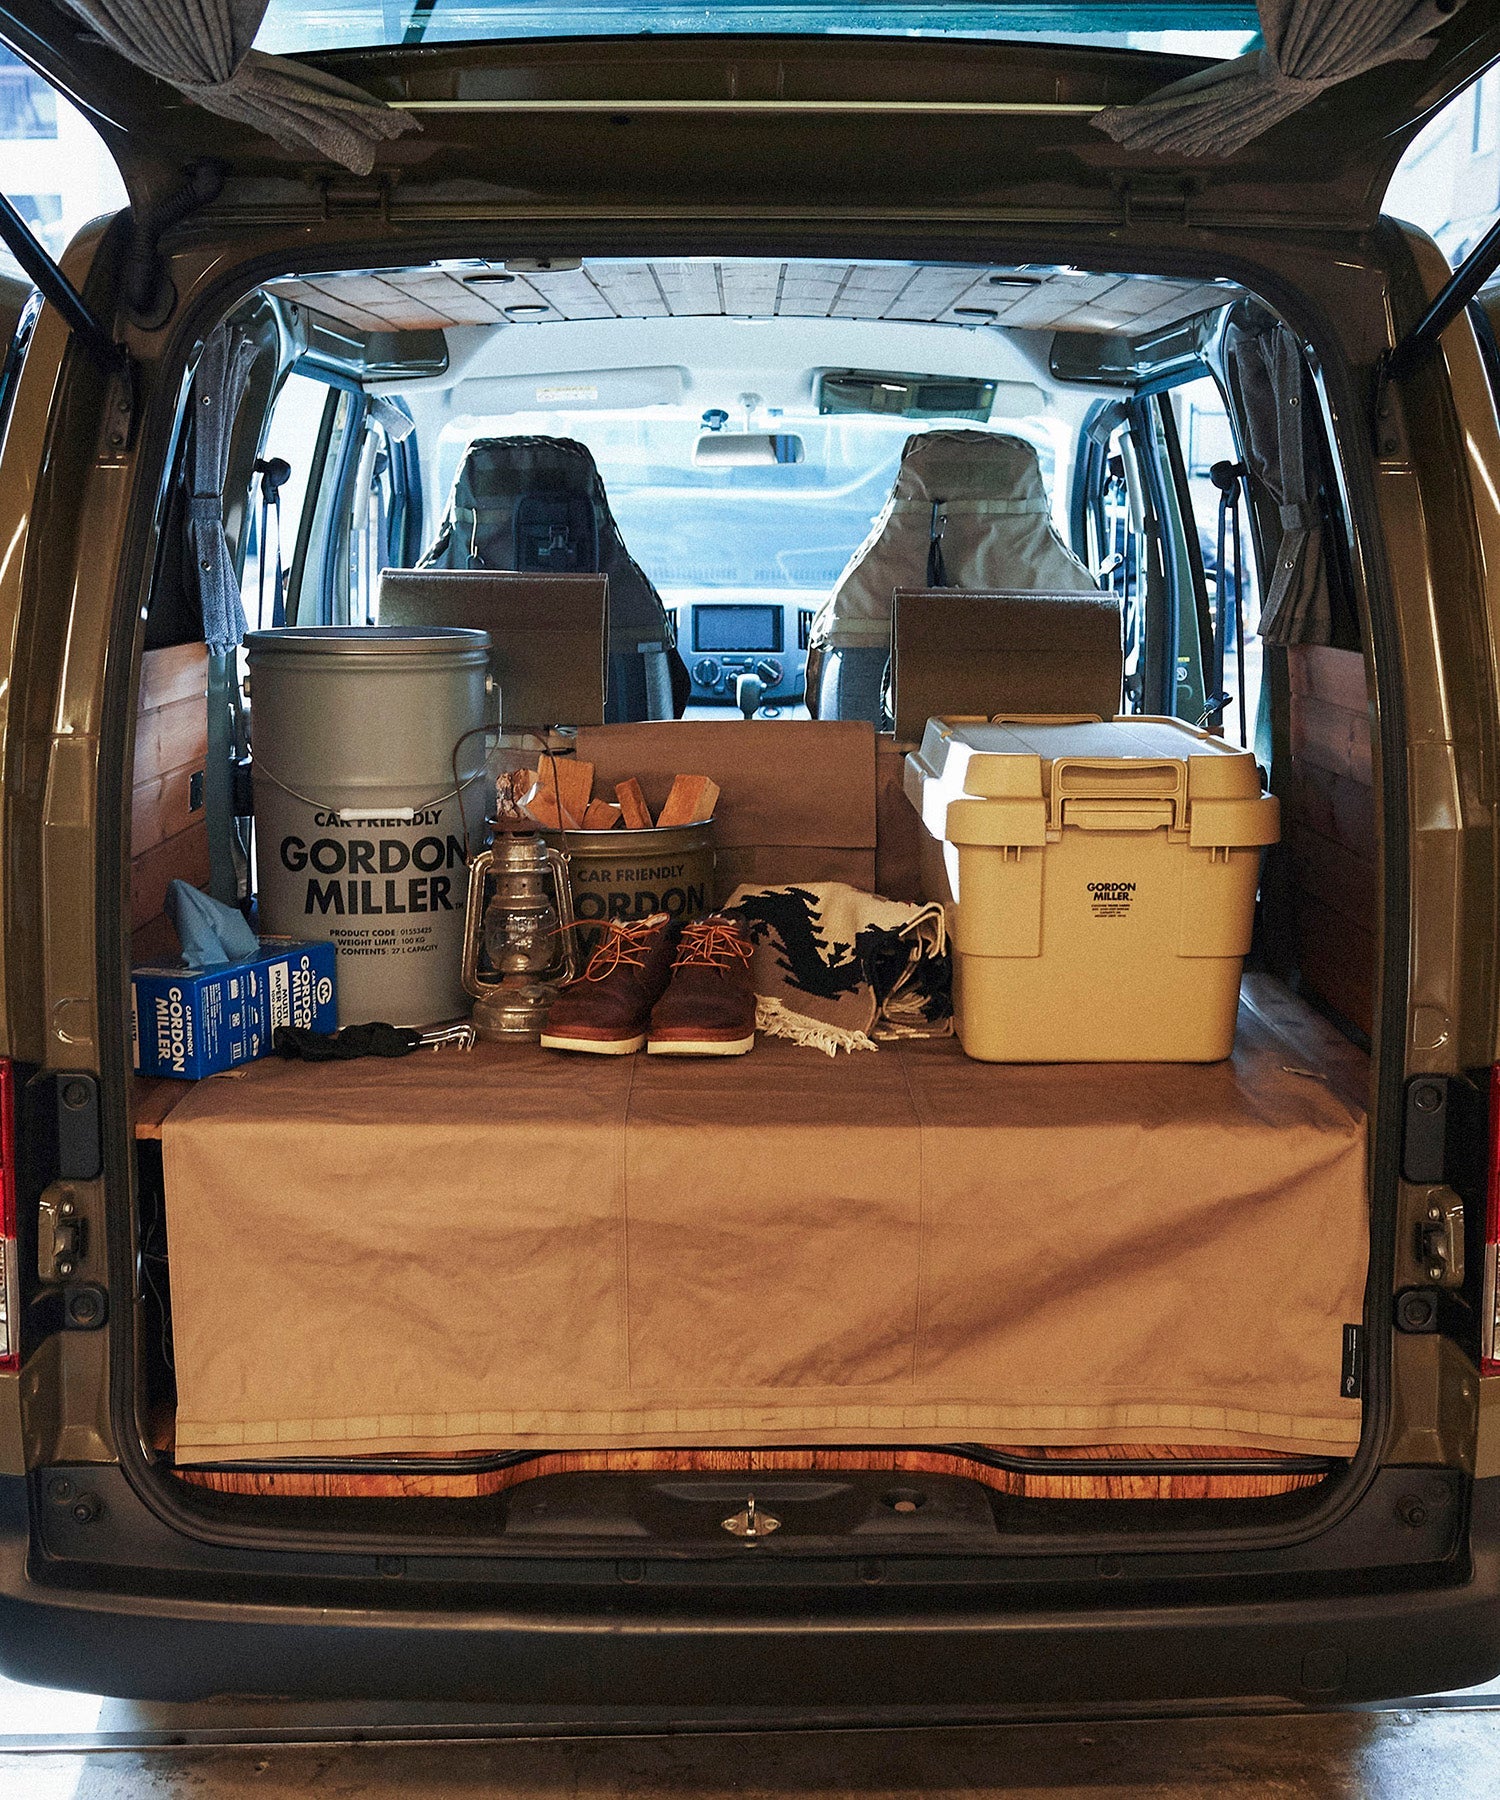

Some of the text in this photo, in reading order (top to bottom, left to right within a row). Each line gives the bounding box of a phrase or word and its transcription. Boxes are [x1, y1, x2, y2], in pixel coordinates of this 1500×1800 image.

[280, 832, 470, 874] GORDON
[577, 864, 685, 882] CAR FRIENDLY
[1087, 882, 1136, 891] GORDON
[304, 877, 454, 915] MILLER
[573, 883, 705, 921] ORDON
[1093, 892, 1129, 901] MILLER
[329, 929, 369, 937] PRODUCT
[338, 938, 372, 947] WEIGHT
[391, 947, 400, 955] 27
[407, 944, 438, 953] CAPACITY
[274, 970, 282, 1003] PAPER
[292, 970, 303, 1028] MILLER
[281, 988, 289, 1019] MULTI
[155, 997, 171, 1060] MILLER
[168, 986, 185, 1072] GORDON
